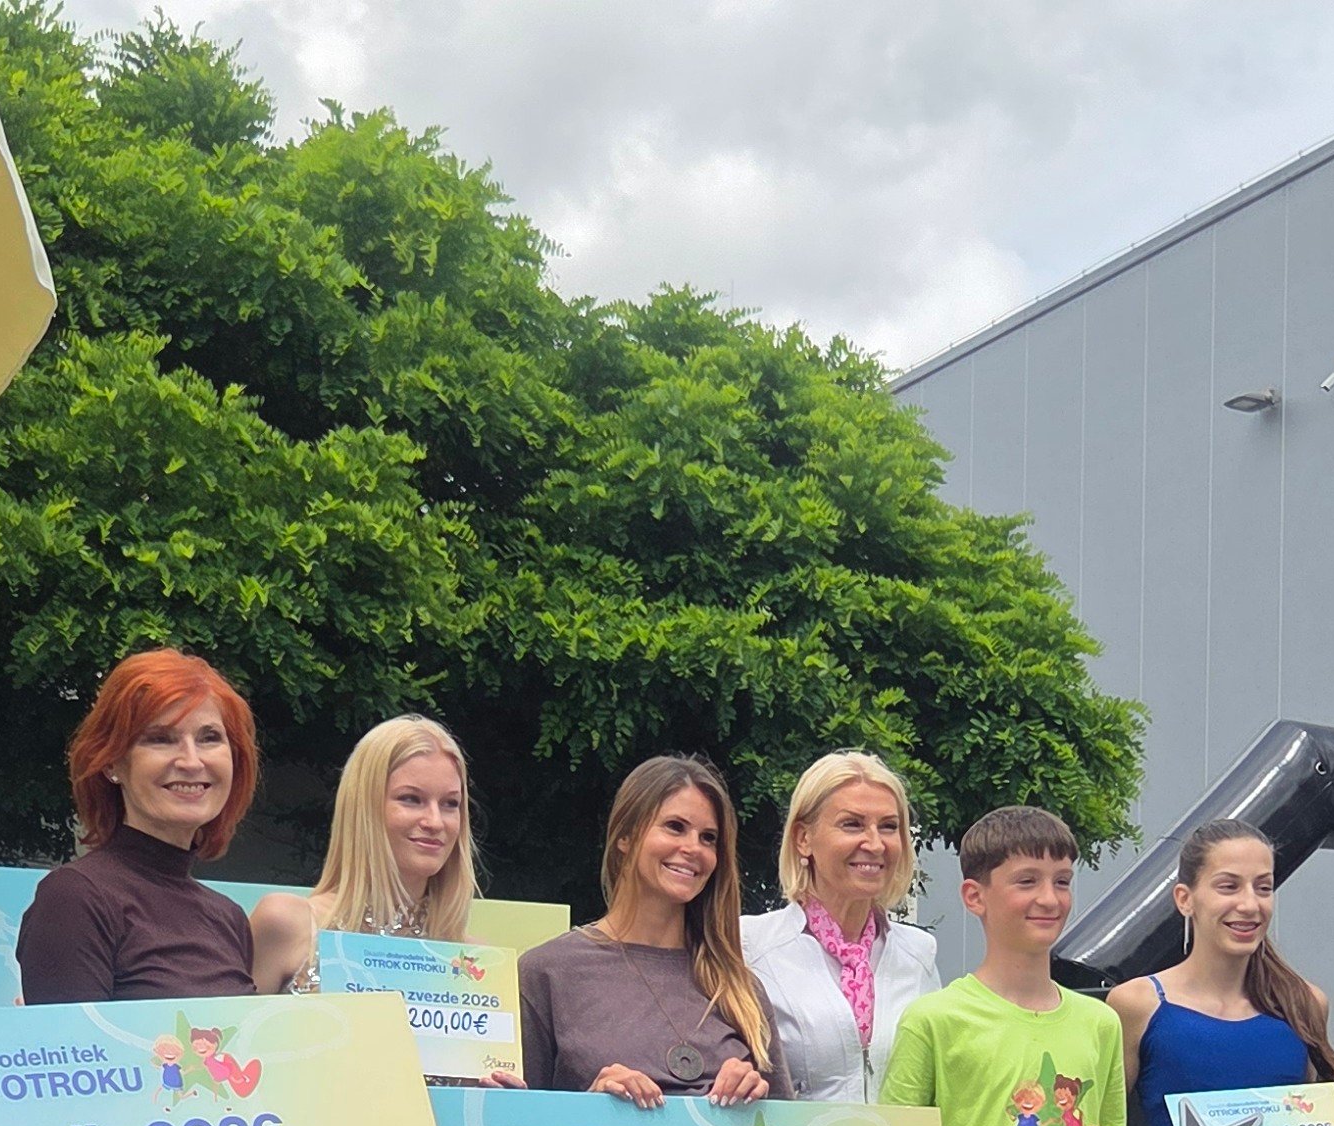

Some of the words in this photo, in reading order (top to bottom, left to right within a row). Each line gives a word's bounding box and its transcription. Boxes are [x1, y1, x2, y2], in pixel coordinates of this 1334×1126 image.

[364, 957, 400, 969] OTROK
[402, 961, 446, 974] OTROKU
[408, 990, 459, 1004] zvezde
[462, 994, 500, 1008] 2026
[70, 1044, 108, 1063] tek
[1, 1066, 143, 1100] OTROKU
